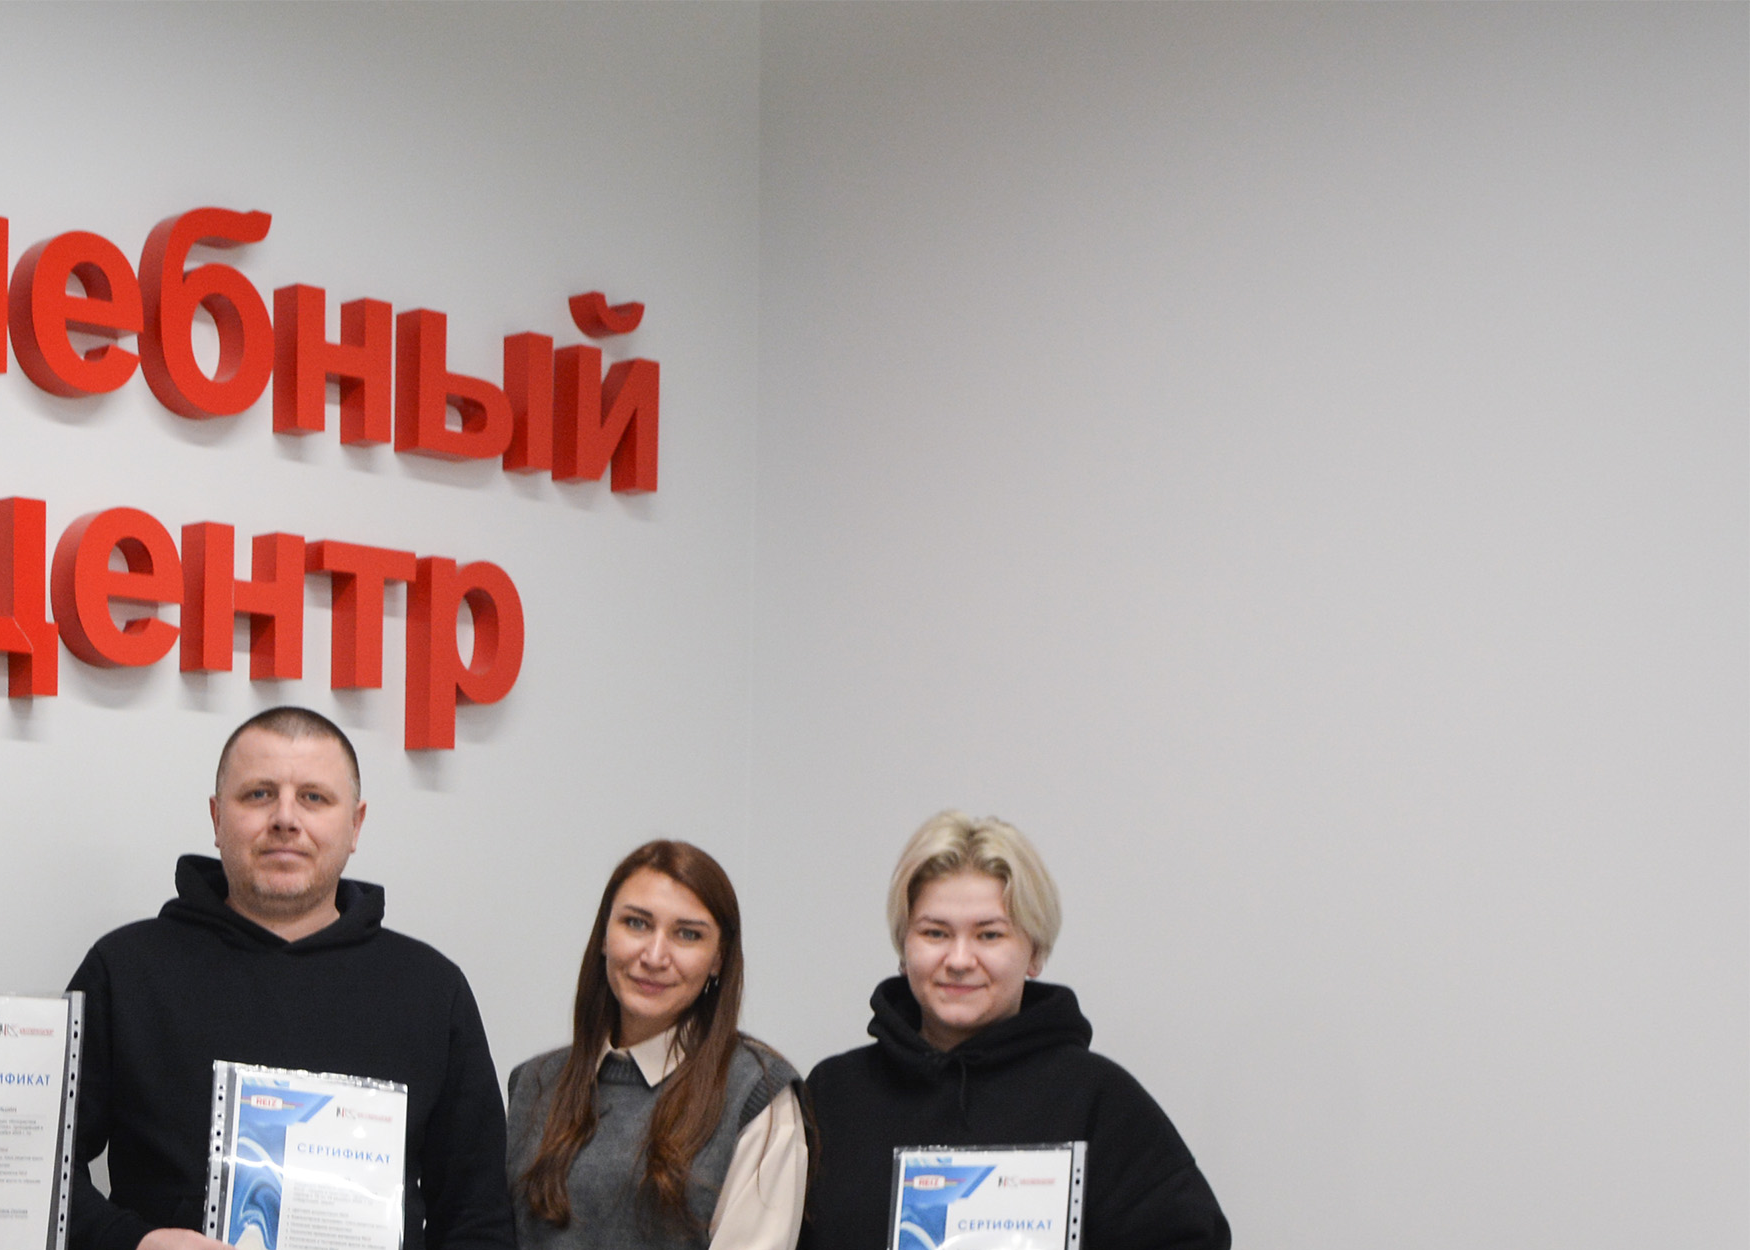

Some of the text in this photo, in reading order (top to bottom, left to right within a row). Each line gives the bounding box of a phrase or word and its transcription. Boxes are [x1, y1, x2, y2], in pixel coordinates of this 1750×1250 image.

[256, 1097, 277, 1107] REIZ
[297, 1143, 390, 1164] СЕРТИФИКАТ
[918, 1178, 939, 1187] REIZ
[957, 1219, 1053, 1231] СЕРТИФИКАТ
